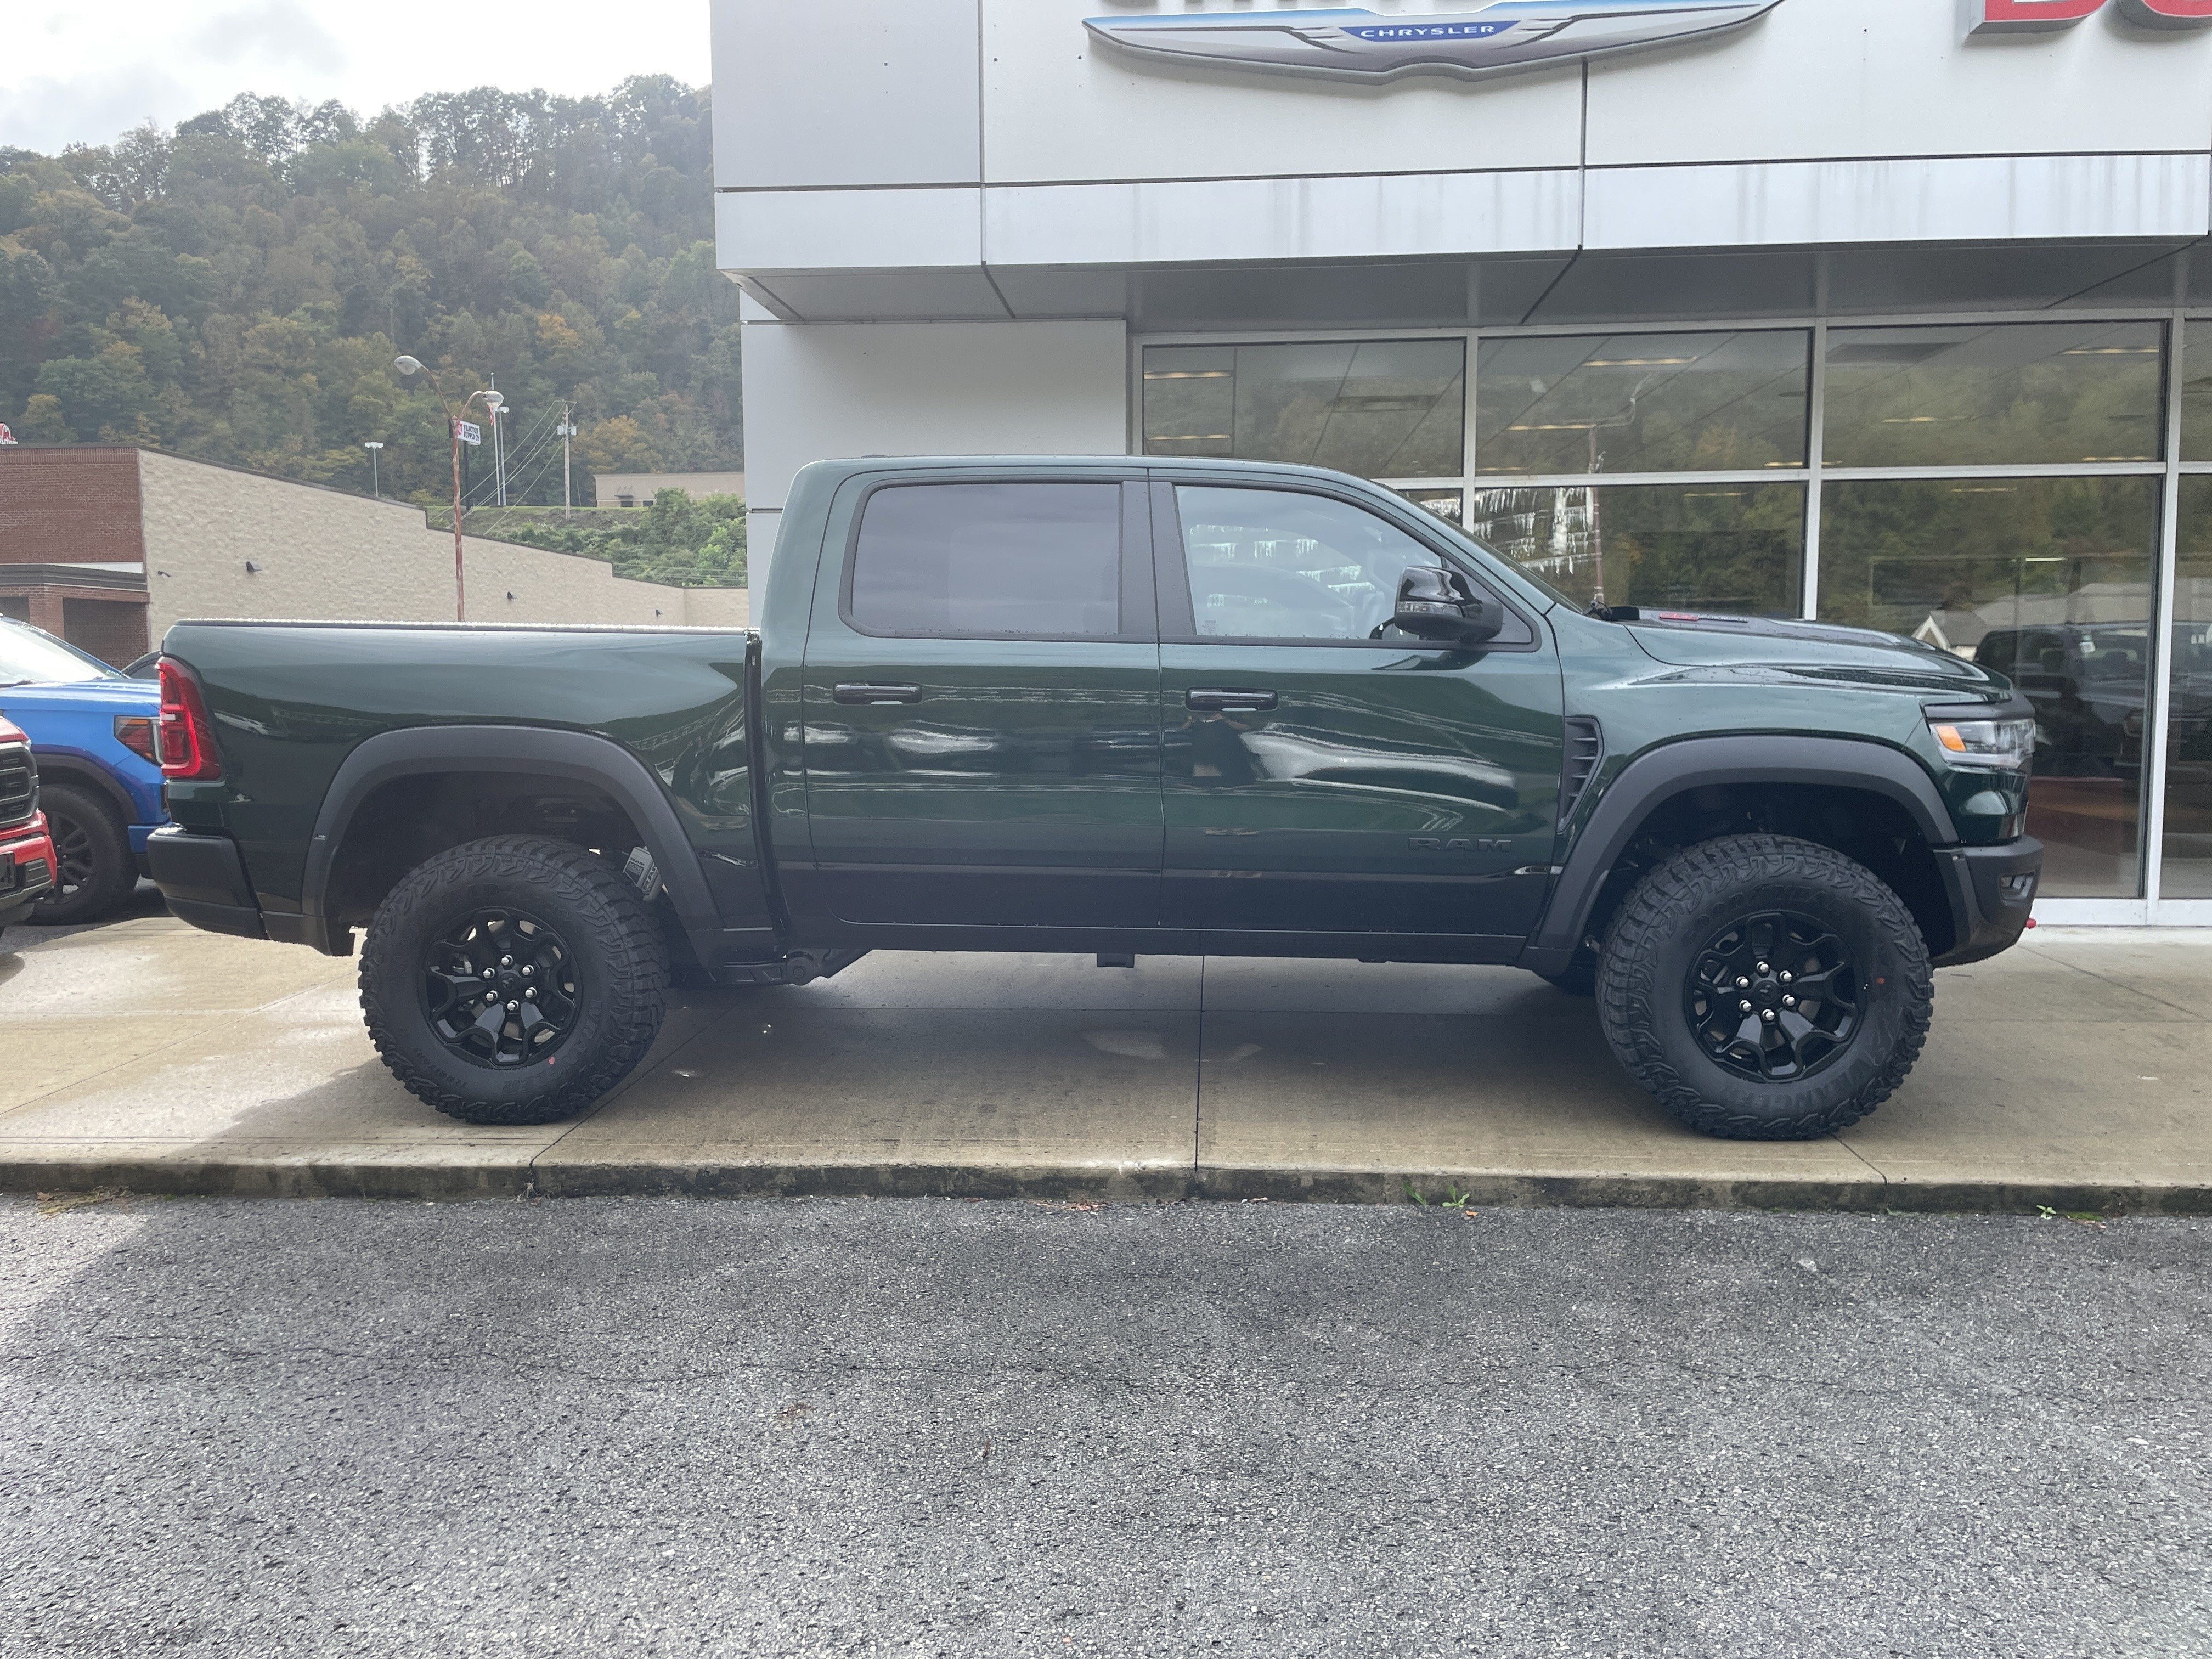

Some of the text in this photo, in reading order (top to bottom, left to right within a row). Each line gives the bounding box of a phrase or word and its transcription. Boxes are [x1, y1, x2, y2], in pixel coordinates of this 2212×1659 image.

[1360, 25, 1494, 37] CHRYSLER
[1408, 837, 1511, 851] RAM
[1720, 1057, 1872, 1110] WRANGLER
